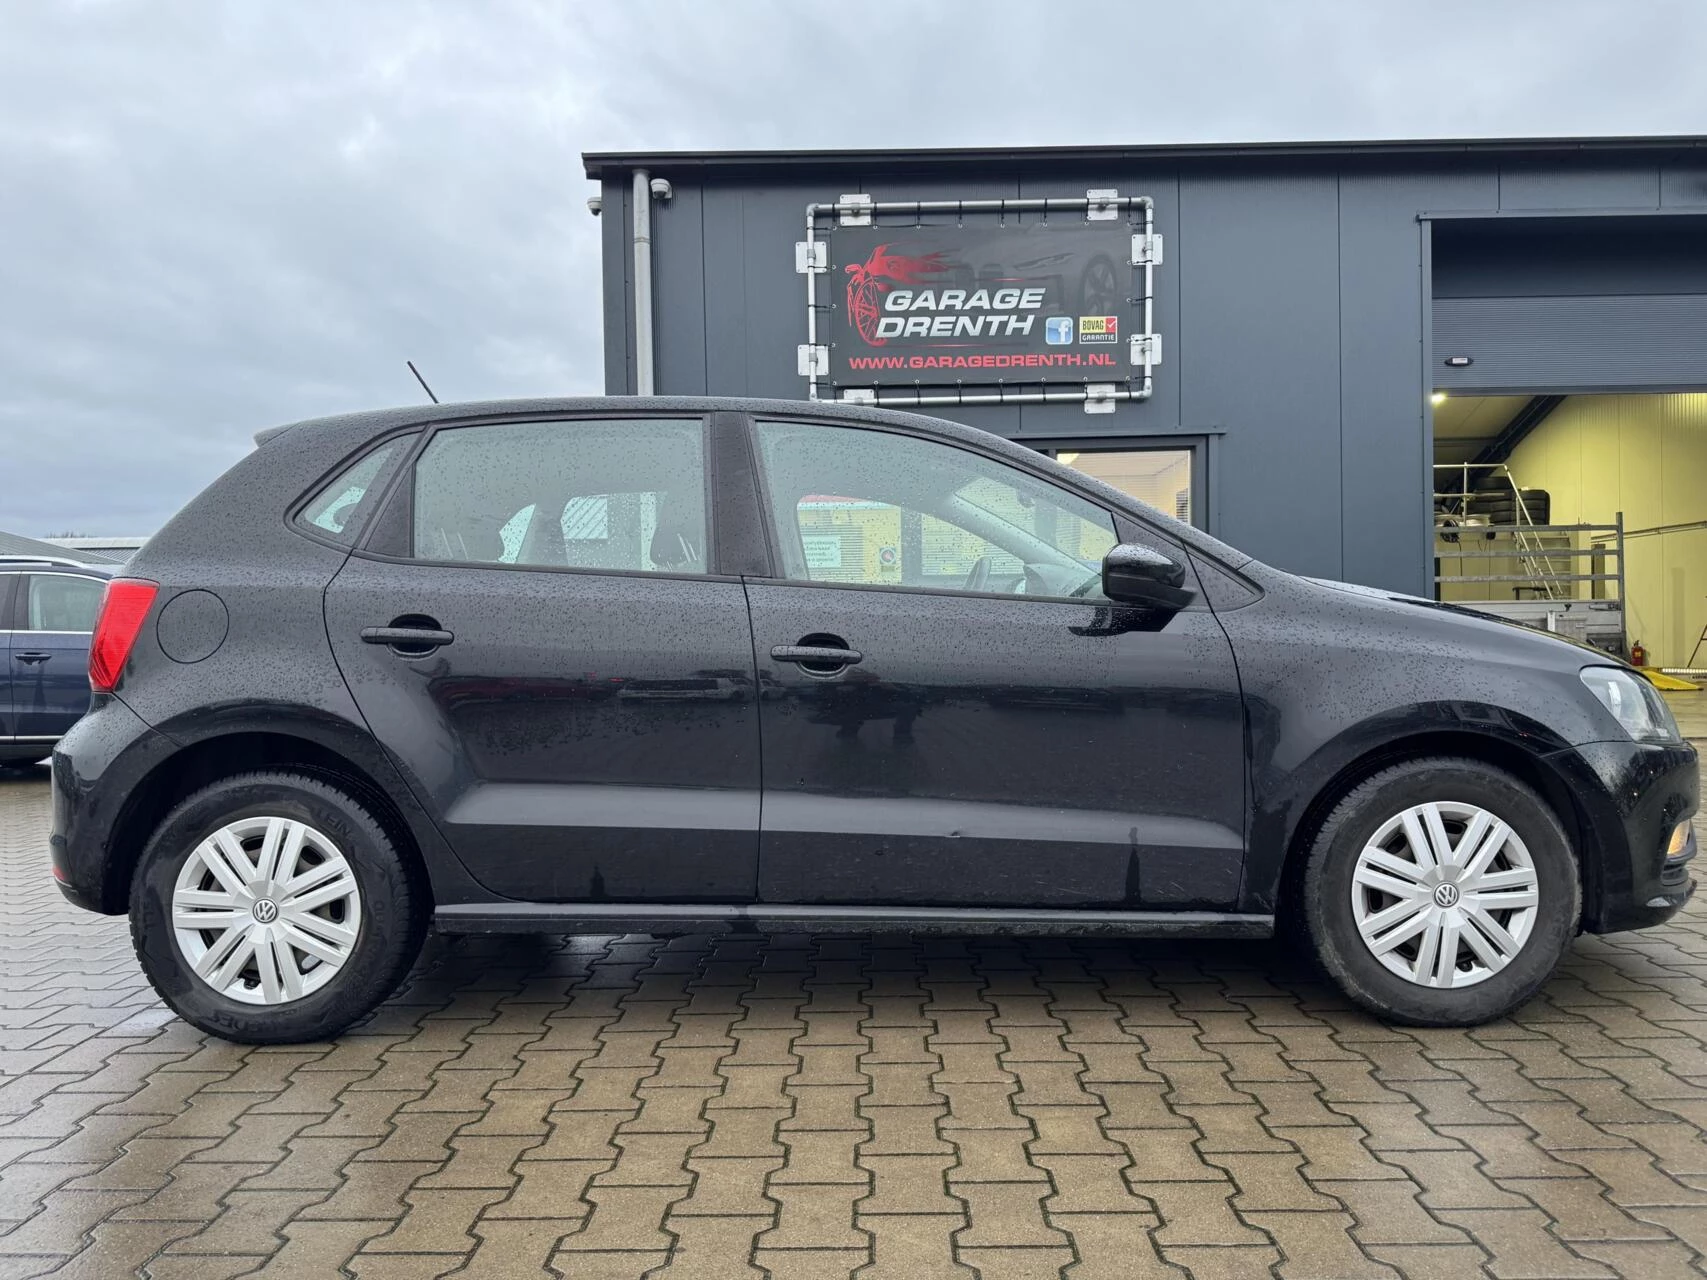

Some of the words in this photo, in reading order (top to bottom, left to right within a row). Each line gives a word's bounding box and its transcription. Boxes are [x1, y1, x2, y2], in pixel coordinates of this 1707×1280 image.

[885, 288, 1046, 311] GARAGE
[876, 315, 1035, 338] DRENTH
[1082, 320, 1104, 331] BOVAG
[849, 353, 1117, 369] WWW.GARAGEDRENTH.NL
